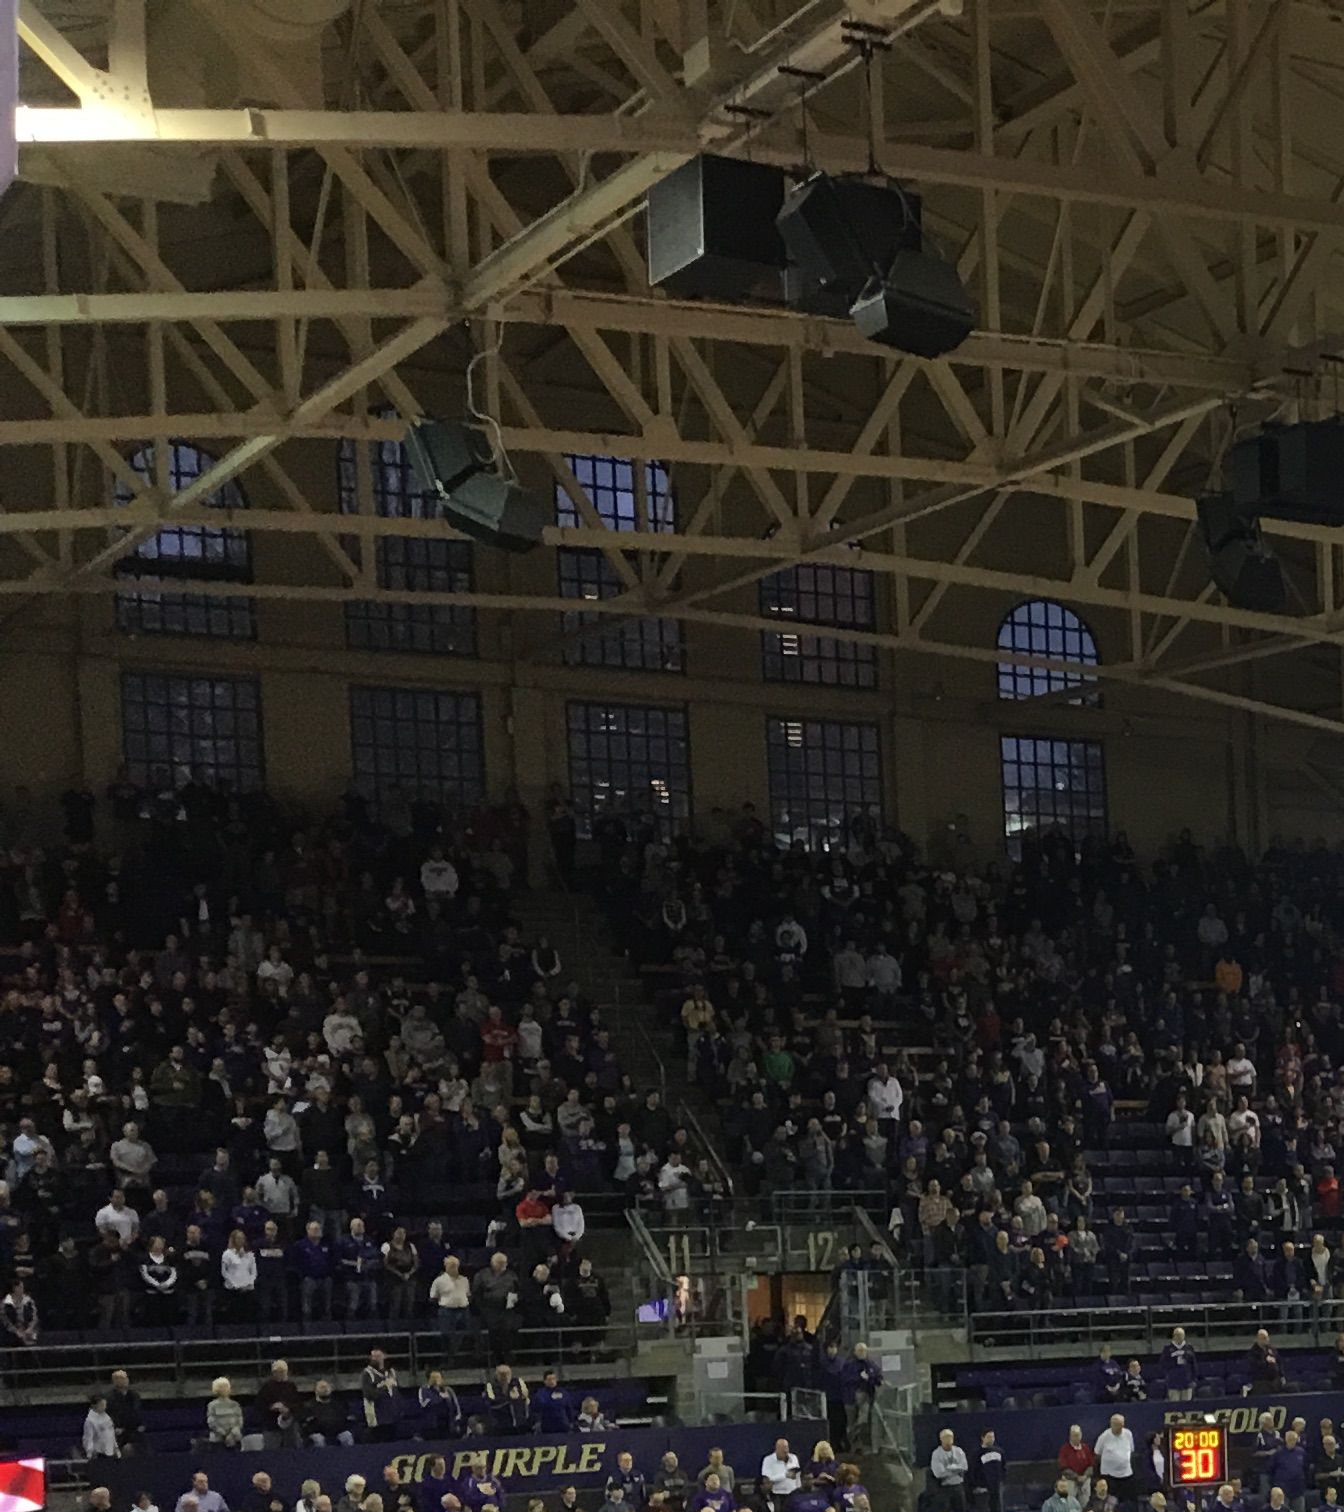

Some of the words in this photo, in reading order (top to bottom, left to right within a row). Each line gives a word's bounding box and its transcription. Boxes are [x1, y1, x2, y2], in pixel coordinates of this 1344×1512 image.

[1175, 1431, 1219, 1449] 20:00
[452, 1443, 606, 1480] PURPLE
[1181, 1449, 1214, 1480] 30
